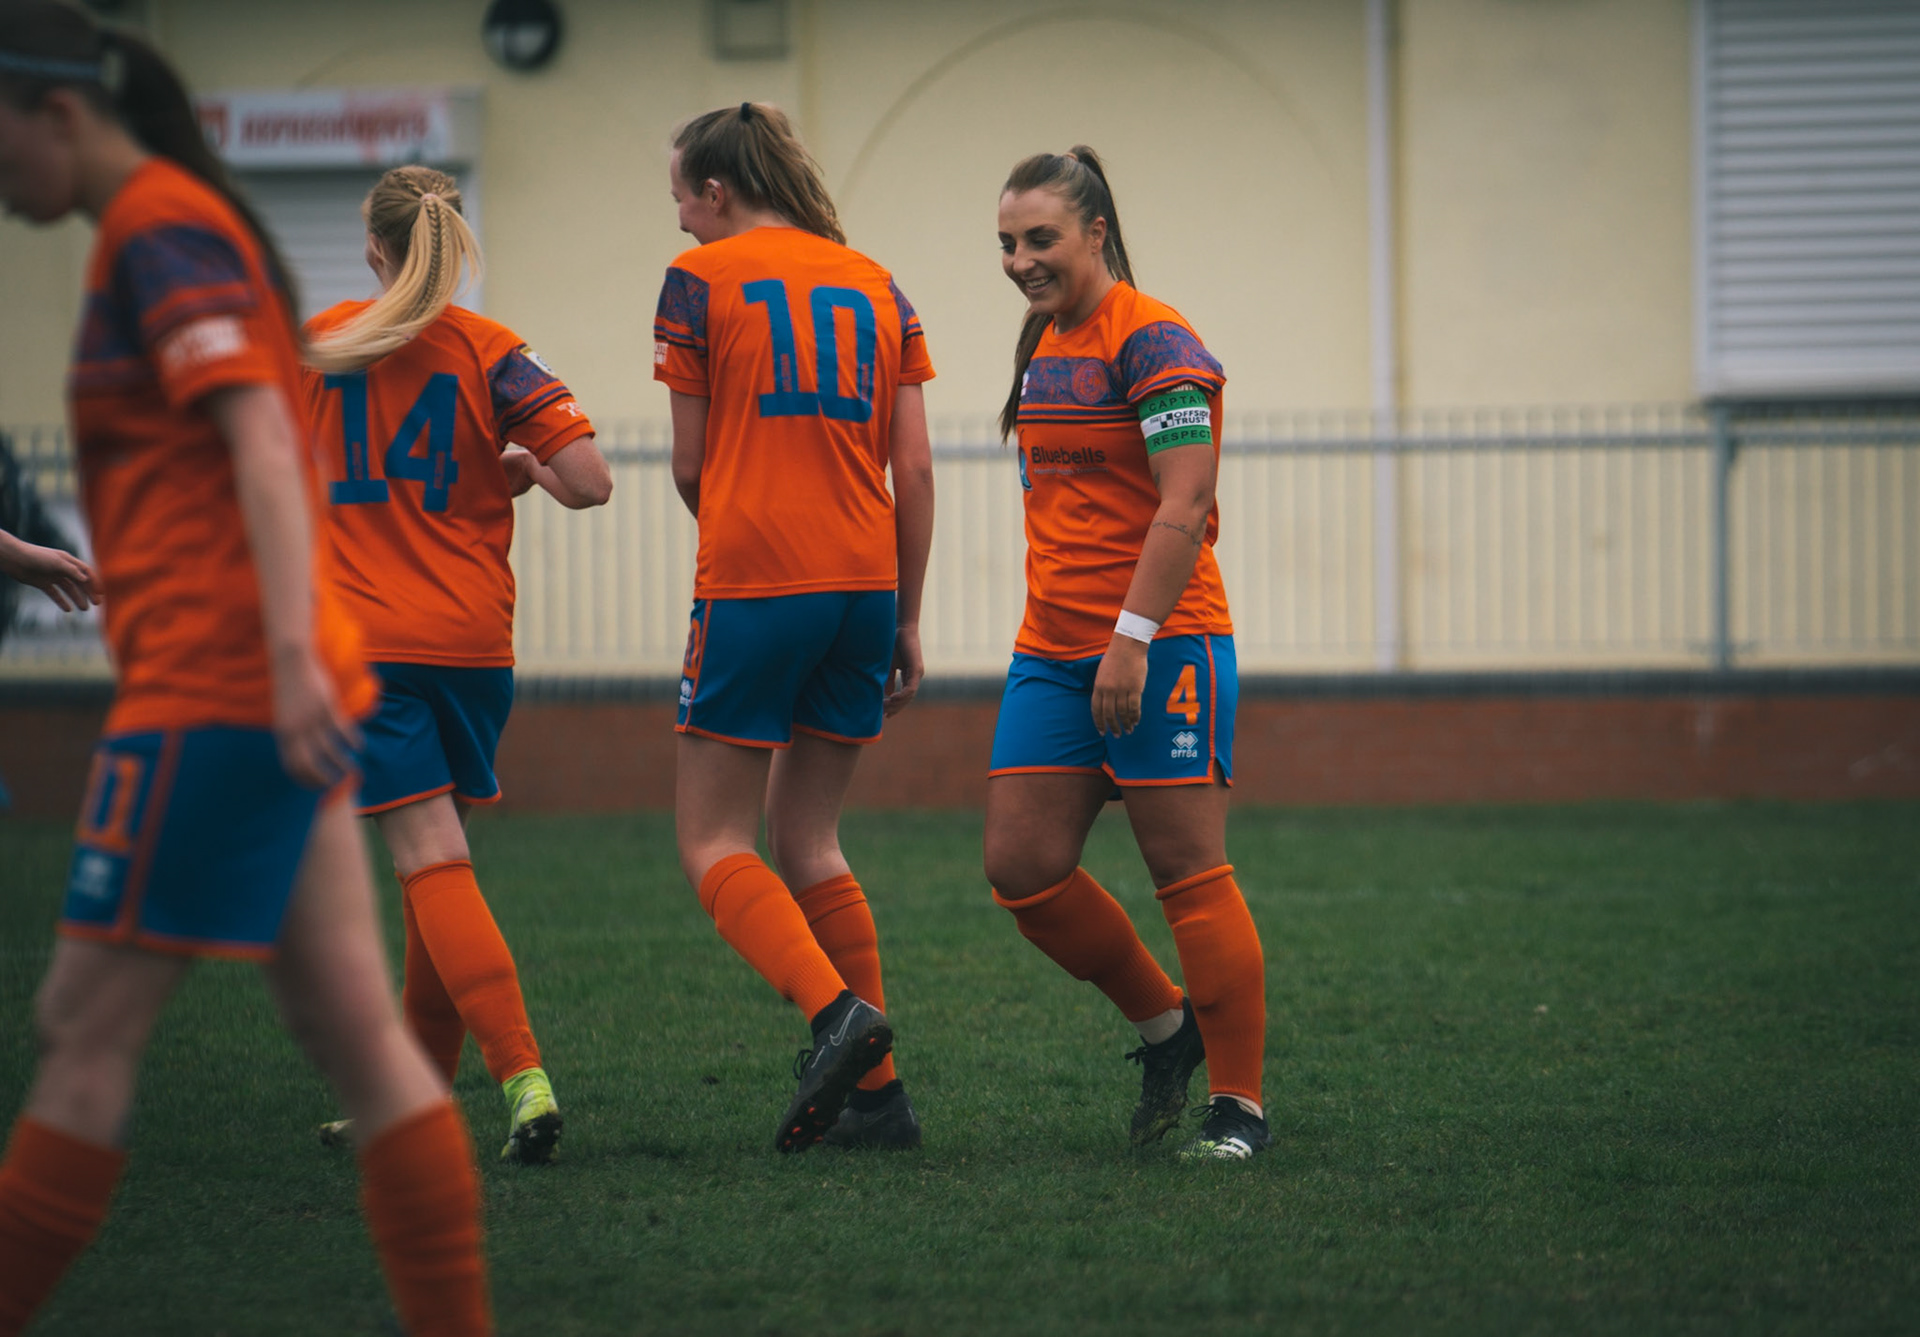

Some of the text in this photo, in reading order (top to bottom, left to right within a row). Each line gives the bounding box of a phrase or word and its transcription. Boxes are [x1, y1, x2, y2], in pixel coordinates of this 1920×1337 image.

[741, 278, 877, 424] 10
[323, 370, 459, 512] 14
[1174, 417, 1205, 425] TRUST
[1031, 446, 1106, 464] Bluebells
[1166, 664, 1200, 725] 4
